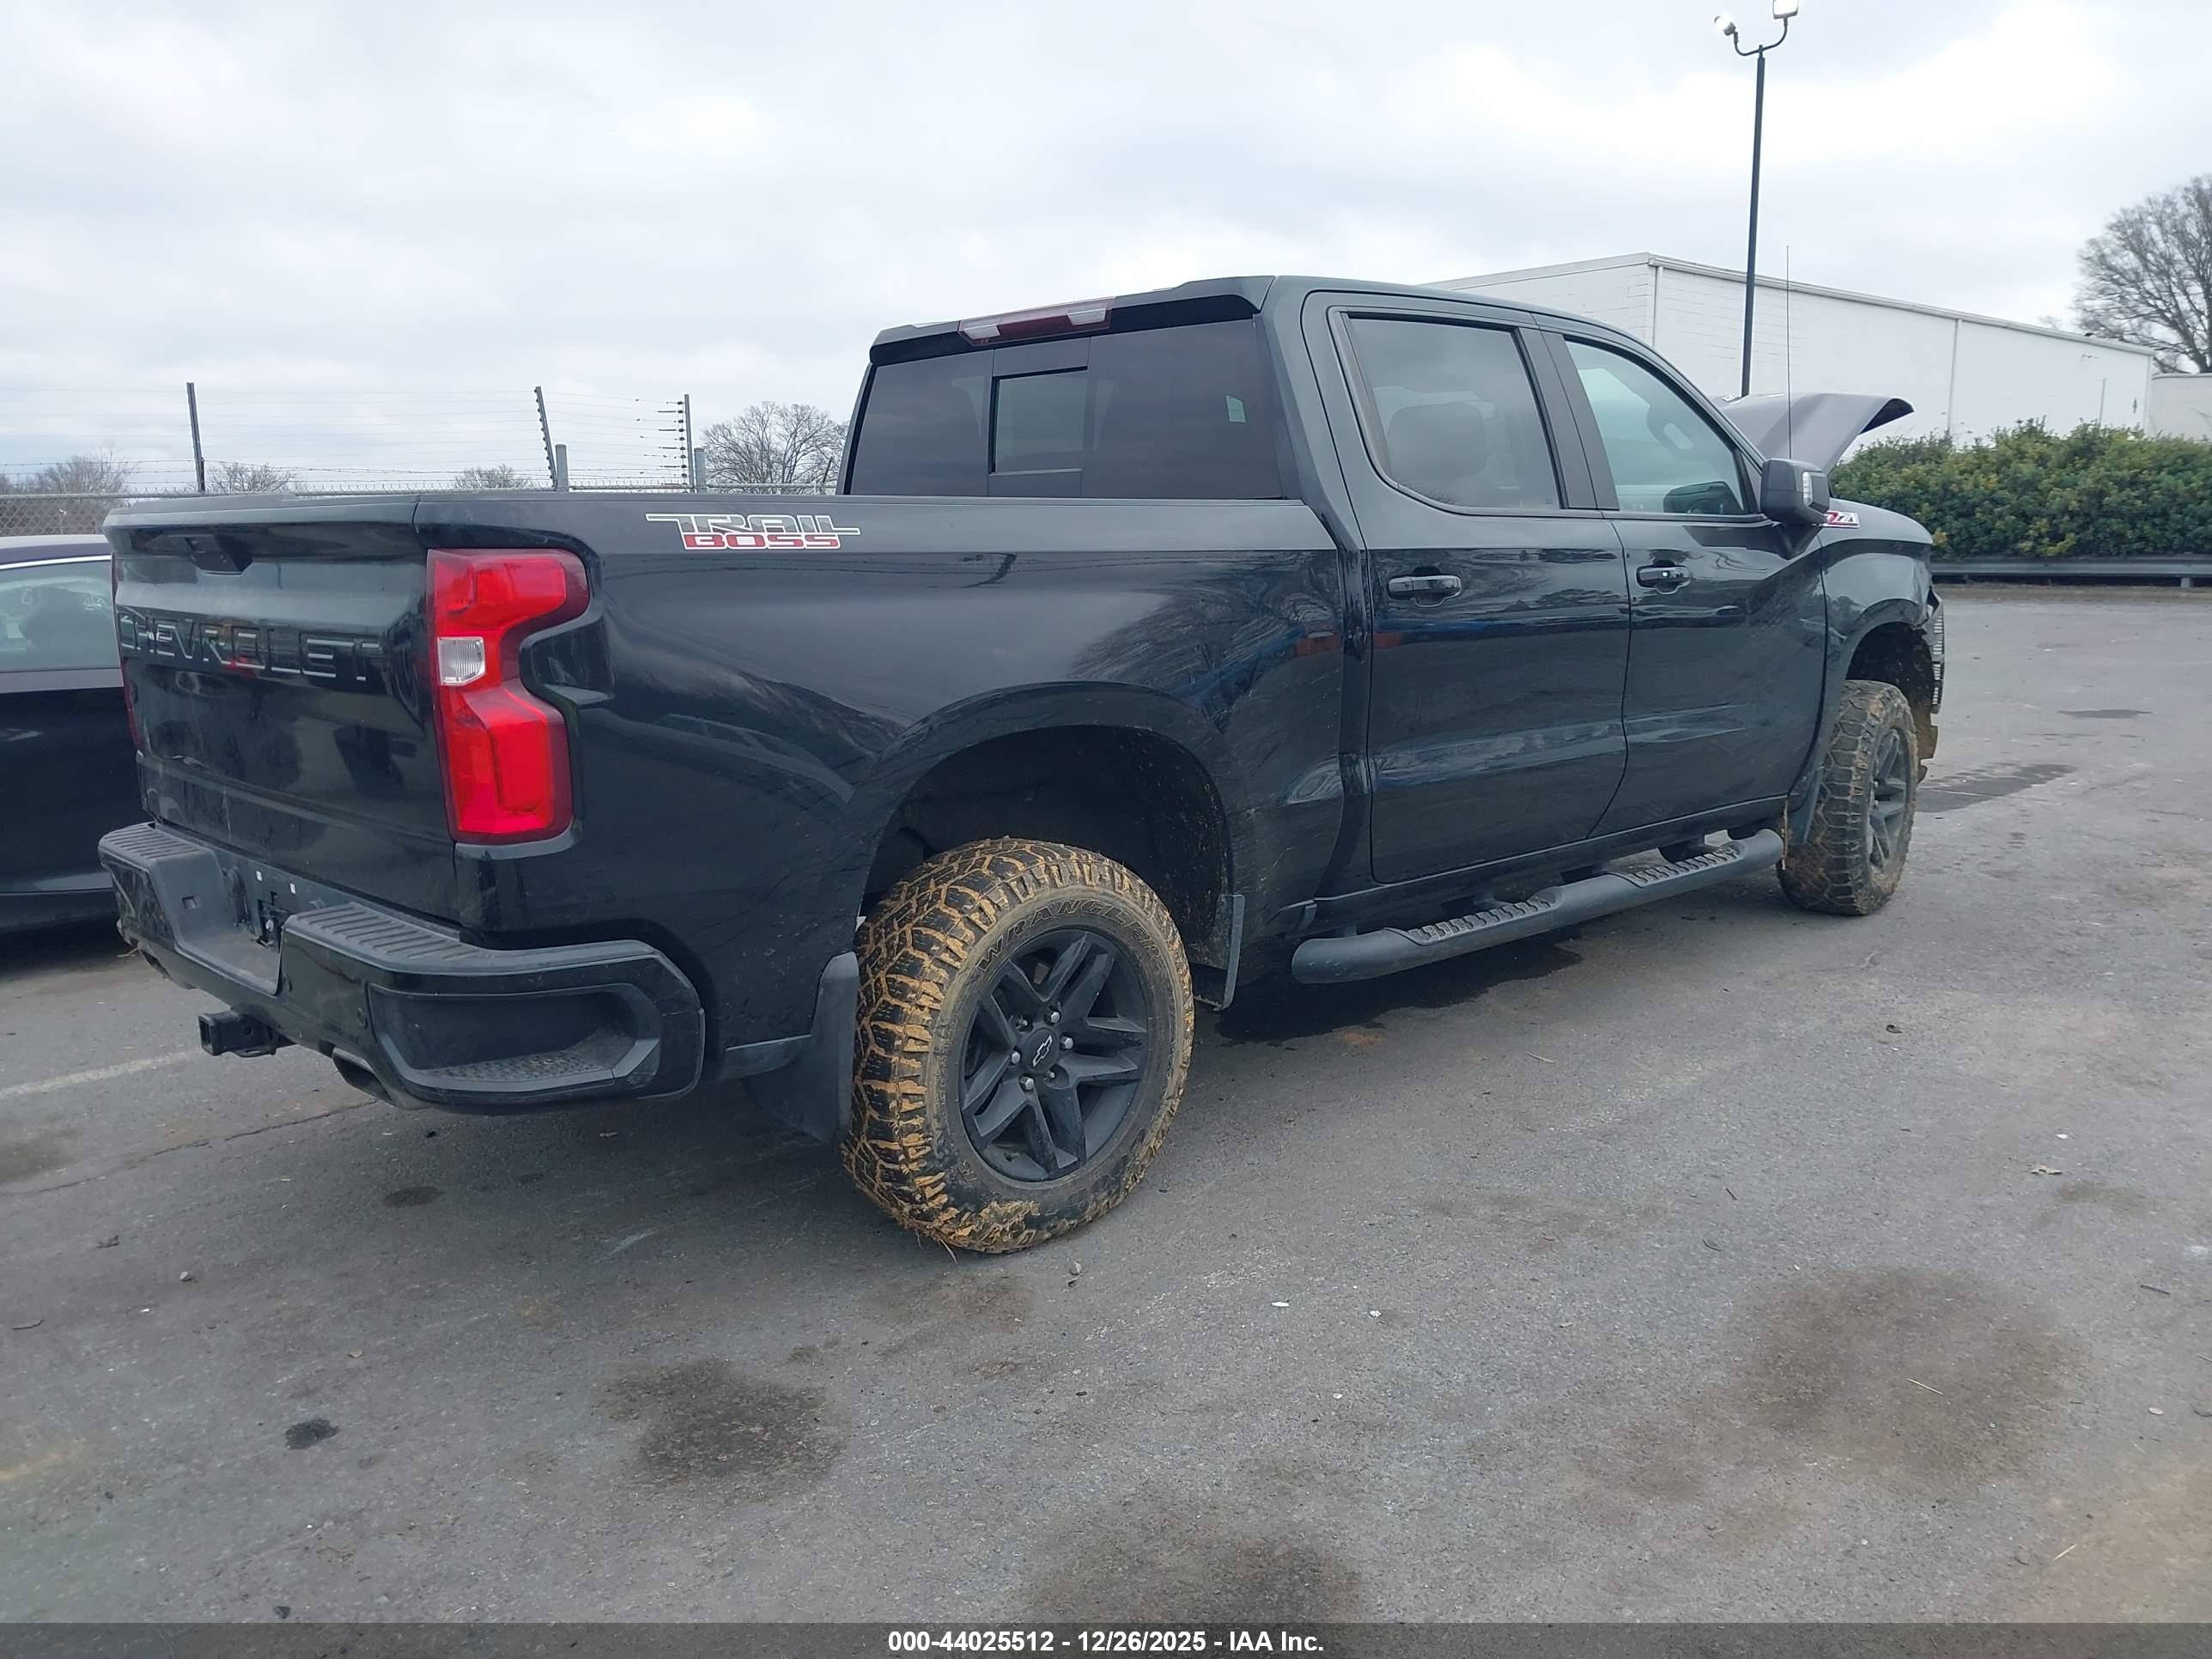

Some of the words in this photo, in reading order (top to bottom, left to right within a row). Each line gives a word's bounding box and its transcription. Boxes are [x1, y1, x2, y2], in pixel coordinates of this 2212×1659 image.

[645, 514, 860, 535] TRAIL
[683, 532, 841, 550] BOSS
[117, 611, 383, 682] CHEVROLET
[975, 899, 1160, 972] WRANGLER
